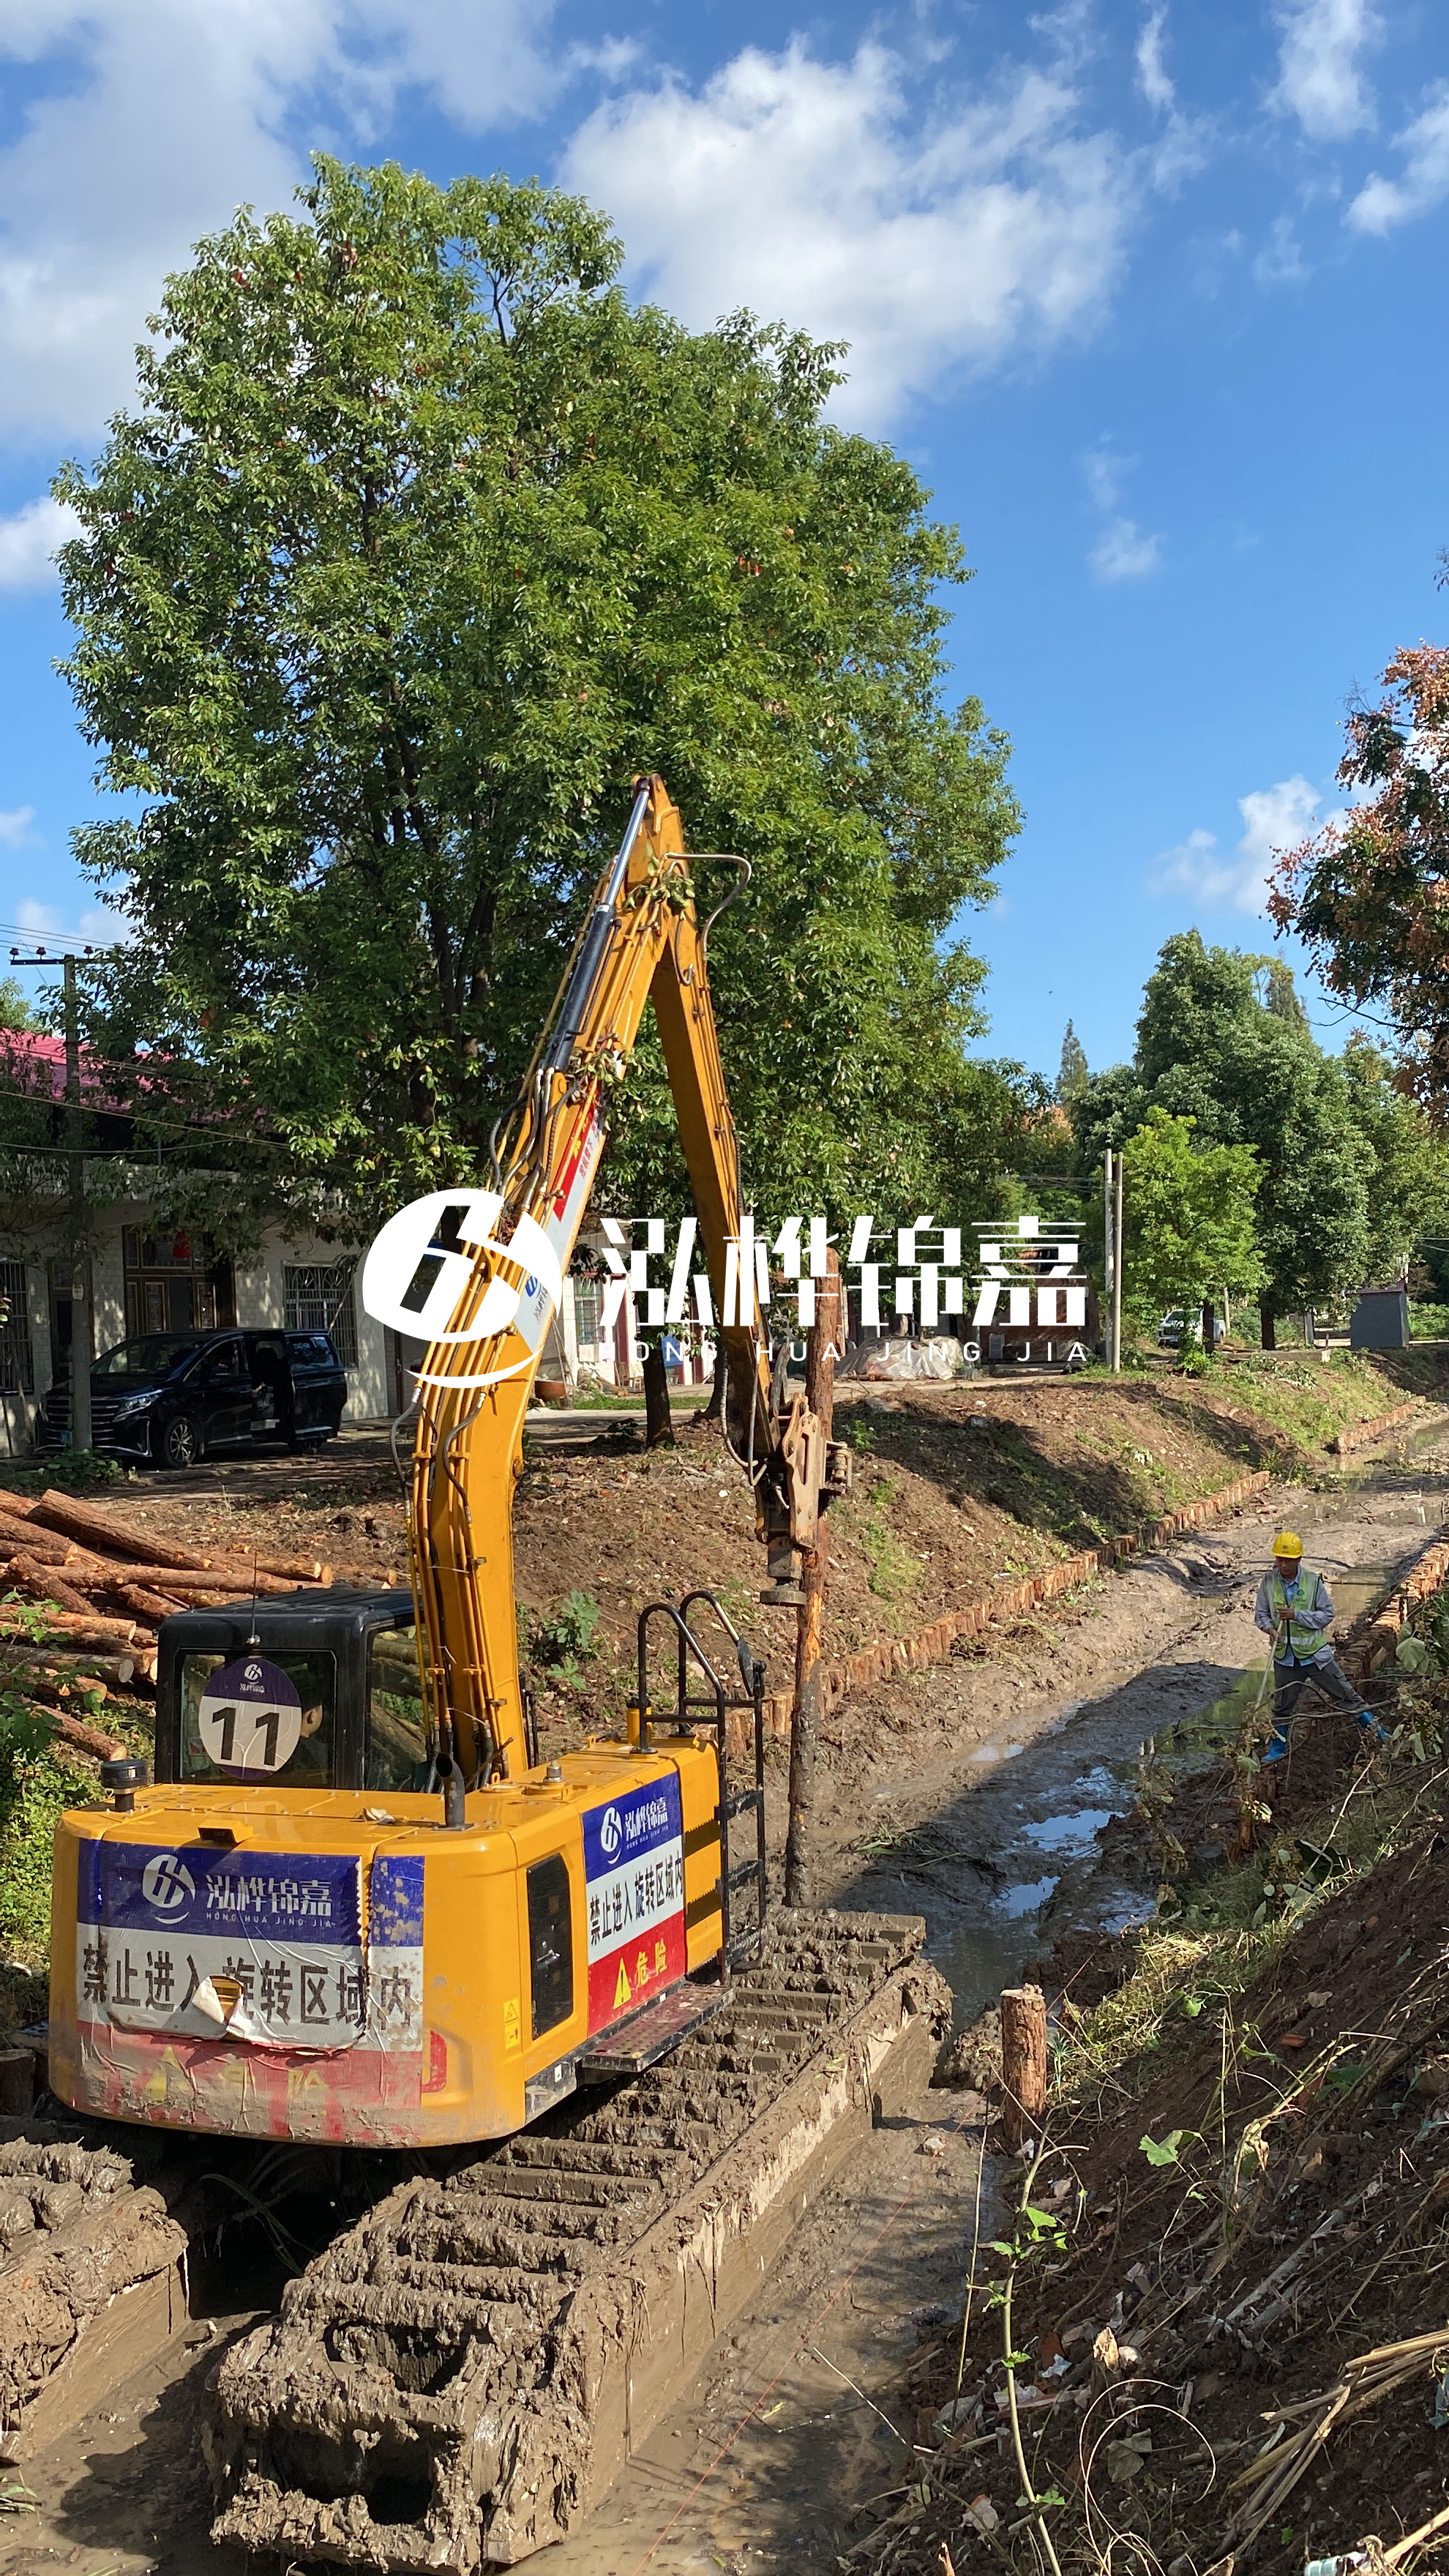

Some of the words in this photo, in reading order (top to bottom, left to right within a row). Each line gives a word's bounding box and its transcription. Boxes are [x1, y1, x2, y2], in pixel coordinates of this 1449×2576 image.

[211, 1706, 280, 1766] 11
[206, 1874, 332, 1916] 泓桦锦嘉
[244, 1914, 268, 1924] HUA
